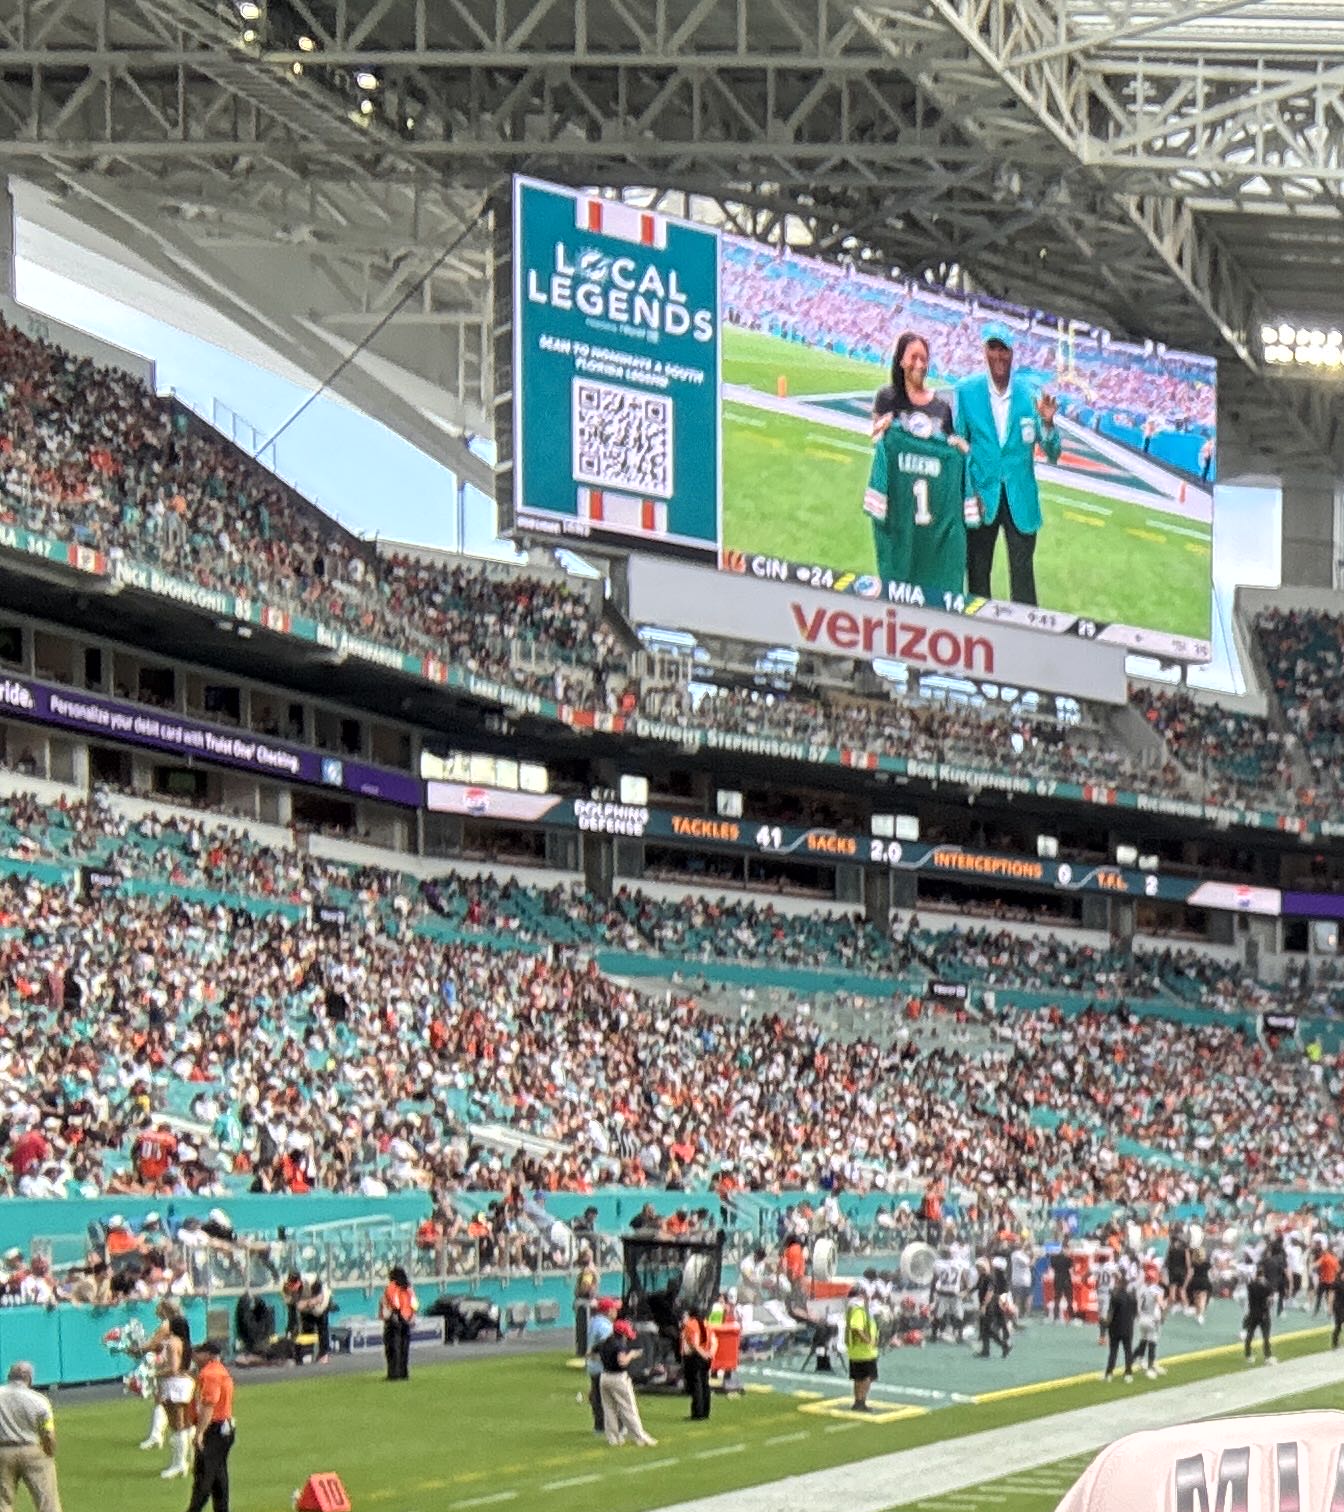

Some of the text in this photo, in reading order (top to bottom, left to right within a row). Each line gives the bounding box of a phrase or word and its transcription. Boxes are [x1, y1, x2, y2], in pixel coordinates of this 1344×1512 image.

[555, 241, 688, 303] LOCAL
[528, 268, 714, 343] LEGENDS
[912, 478, 932, 527] 1
[751, 555, 788, 581] CIN
[811, 566, 834, 588] 24
[888, 580, 925, 608] MIA
[943, 591, 965, 614] 14
[790, 601, 995, 675] verizon
[671, 815, 740, 841] TACKLES
[756, 824, 782, 849] 41
[806, 832, 856, 855] SACKS
[870, 839, 903, 863] 2.0
[933, 850, 1043, 880] INTERCEPTIONS
[318, 1478, 345, 1506] 10
